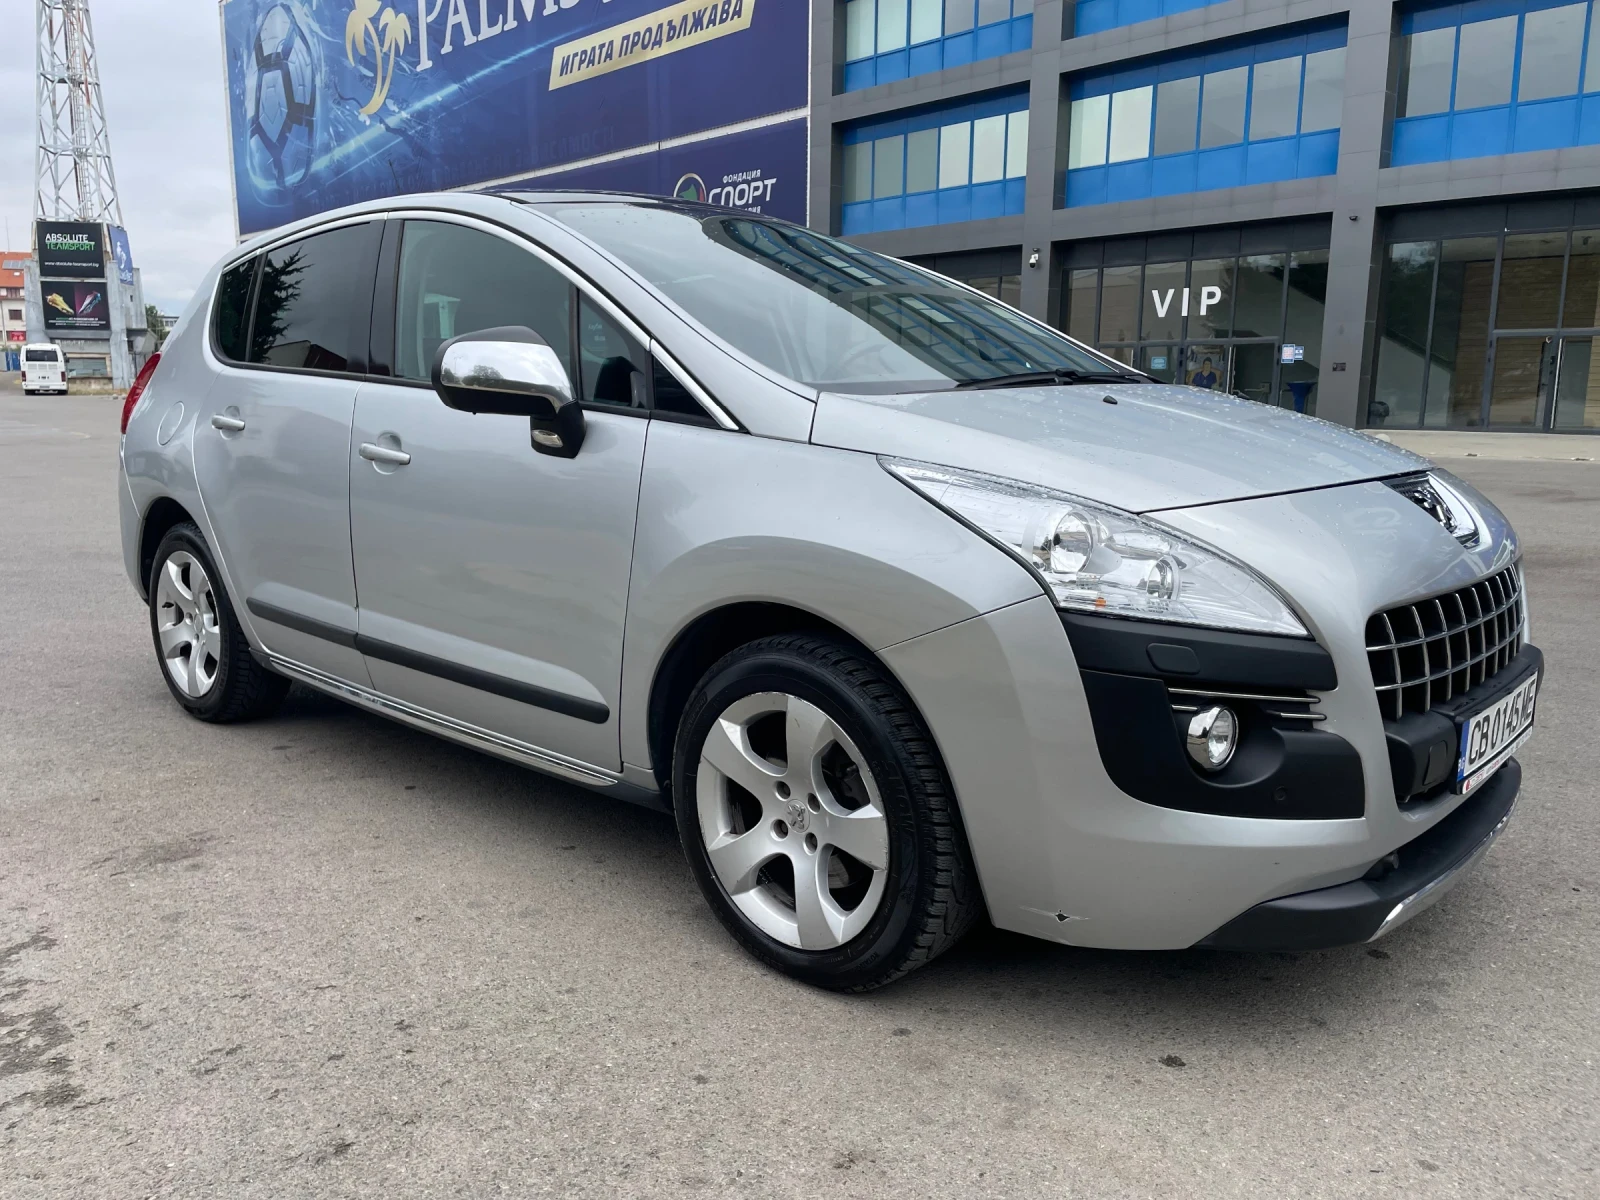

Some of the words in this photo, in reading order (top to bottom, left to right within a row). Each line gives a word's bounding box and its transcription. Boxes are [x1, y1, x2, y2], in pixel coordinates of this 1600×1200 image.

[416, 0, 581, 72] PAL
[559, 39, 614, 77] ИГРАТА
[618, 0, 743, 58] ПРОДЪЛЖАВА
[722, 169, 761, 184] ФОНДАЦИЯ
[45, 233, 89, 242] ABSOLUTE
[46, 242, 95, 251] TEAMSPORT
[1152, 286, 1222, 318] VIP
